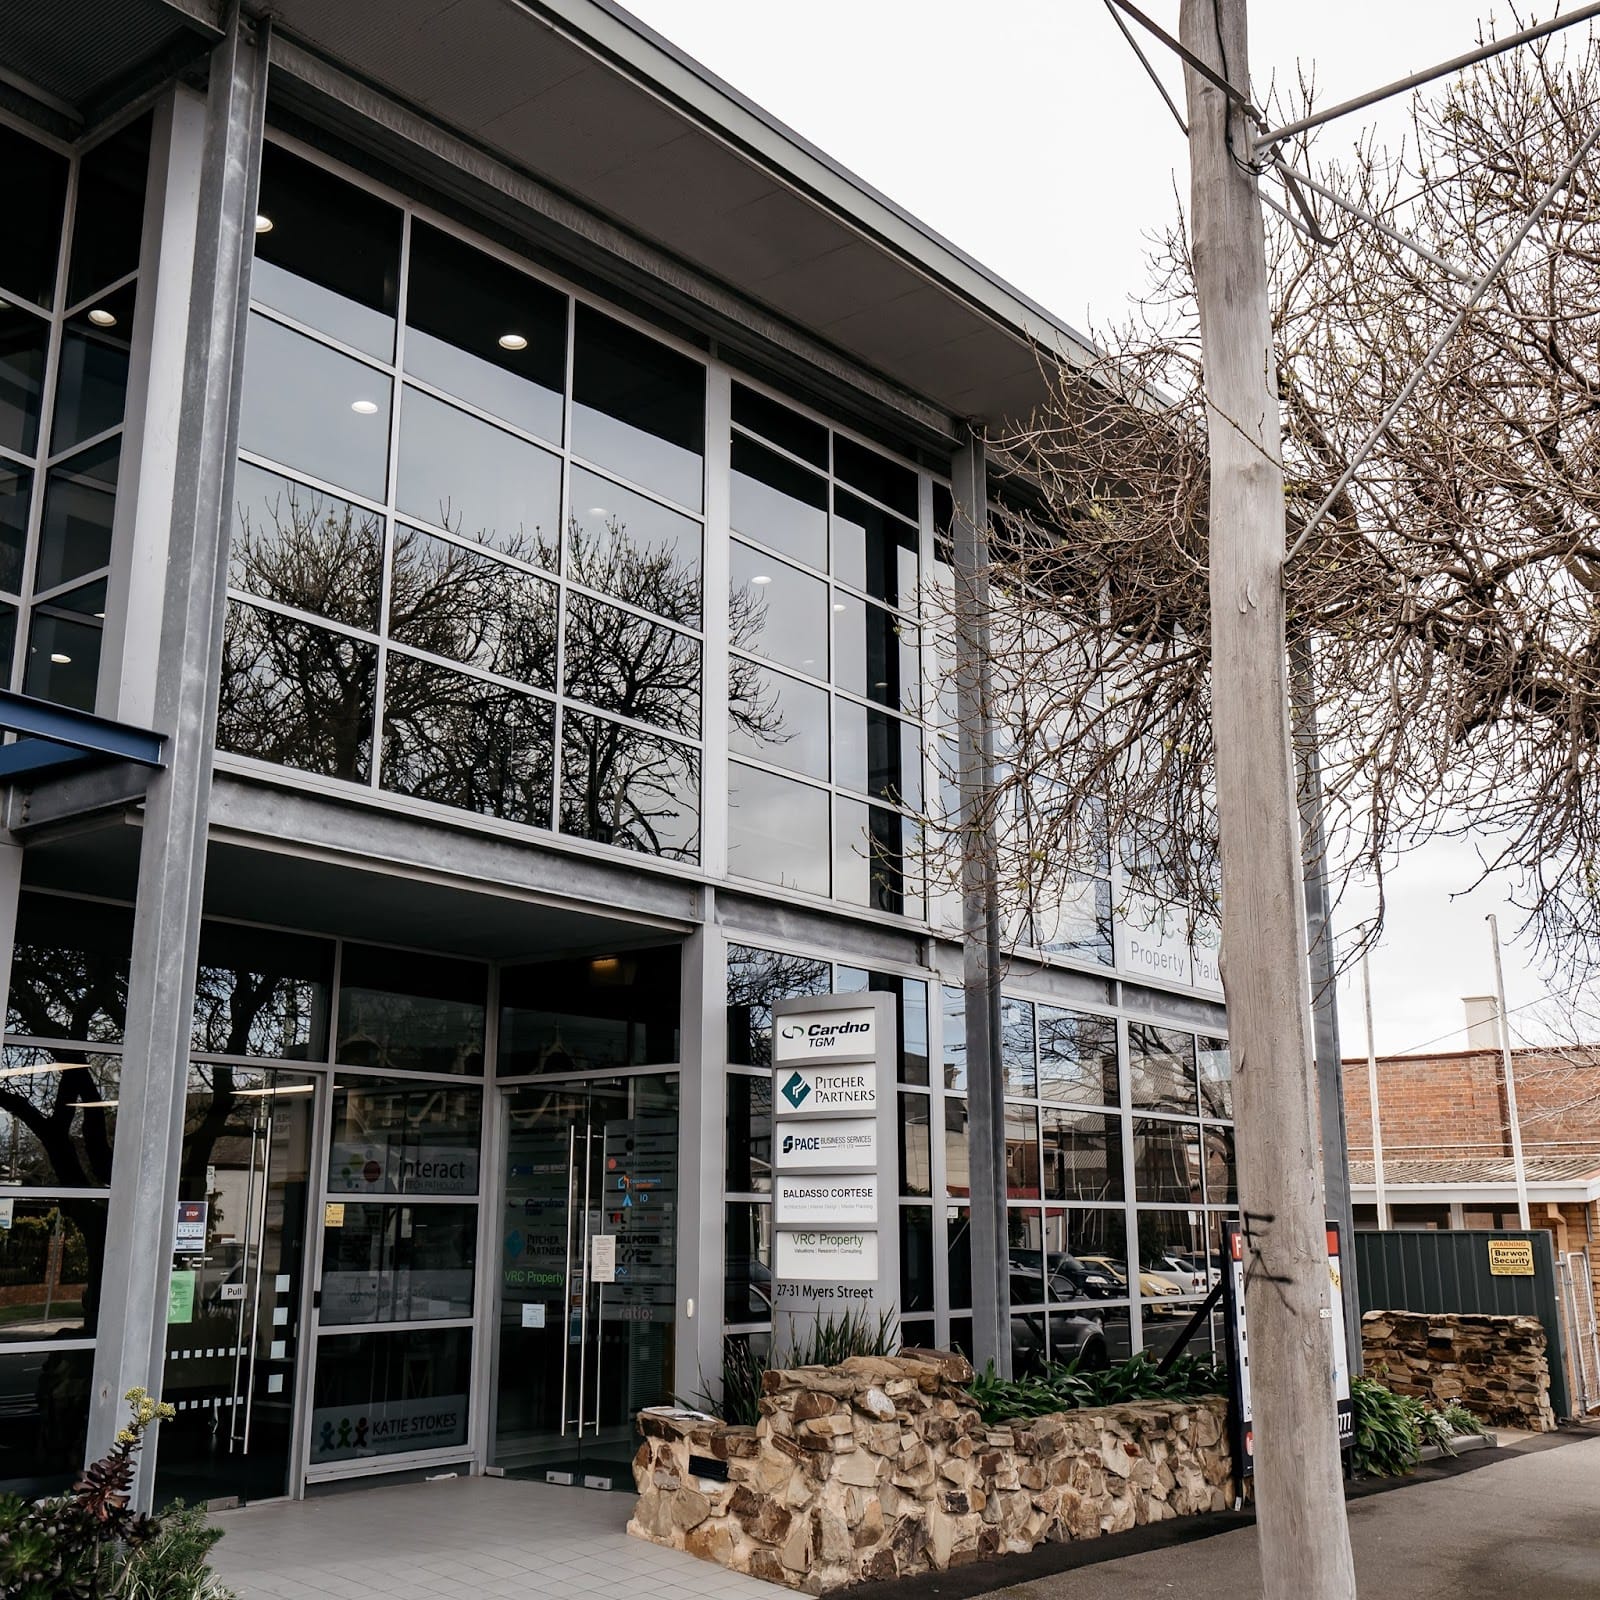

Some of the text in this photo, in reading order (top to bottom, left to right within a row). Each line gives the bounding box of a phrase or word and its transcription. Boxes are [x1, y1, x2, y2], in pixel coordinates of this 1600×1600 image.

[1130, 941, 1184, 977] Property
[807, 1021, 870, 1037] Cardno
[808, 1036, 835, 1048] TGM
[815, 1076, 865, 1089] PITCHER
[815, 1090, 876, 1103] PARTNERS
[820, 1136, 846, 1145] BUSINESS
[846, 1135, 872, 1144] SERVICES
[399, 1156, 465, 1179] interact
[783, 1188, 873, 1198] BALDASSO CORTESE
[527, 1234, 560, 1245] PITCHER
[792, 1234, 864, 1248] VRC Property
[1494, 1249, 1528, 1257] Barwon
[1494, 1257, 1530, 1265] Security
[504, 1270, 565, 1286] VRC Property
[227, 1288, 242, 1296] Pull
[777, 1284, 874, 1300] 27-31 Myers Street
[372, 1412, 457, 1436] KATIE STOKES
